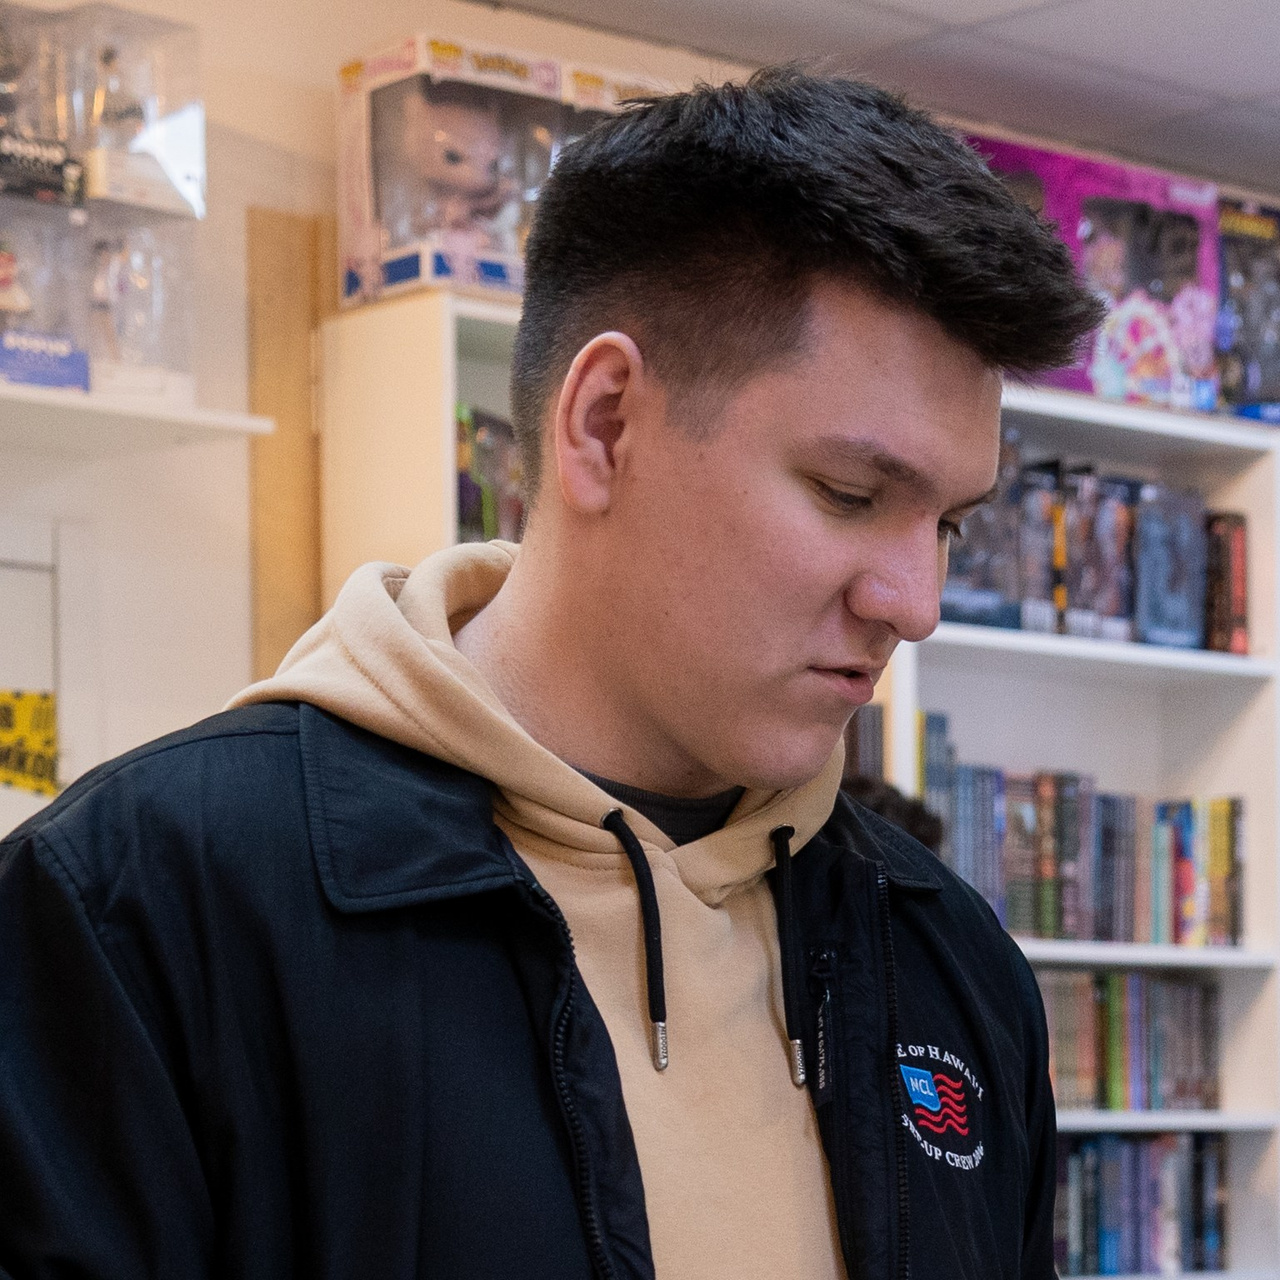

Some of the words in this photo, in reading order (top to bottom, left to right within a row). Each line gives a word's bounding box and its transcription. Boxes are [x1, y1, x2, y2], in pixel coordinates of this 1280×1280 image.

[908, 1044, 926, 1057] OF
[909, 1076, 935, 1097] NCL
[945, 1150, 974, 1170] CREW
